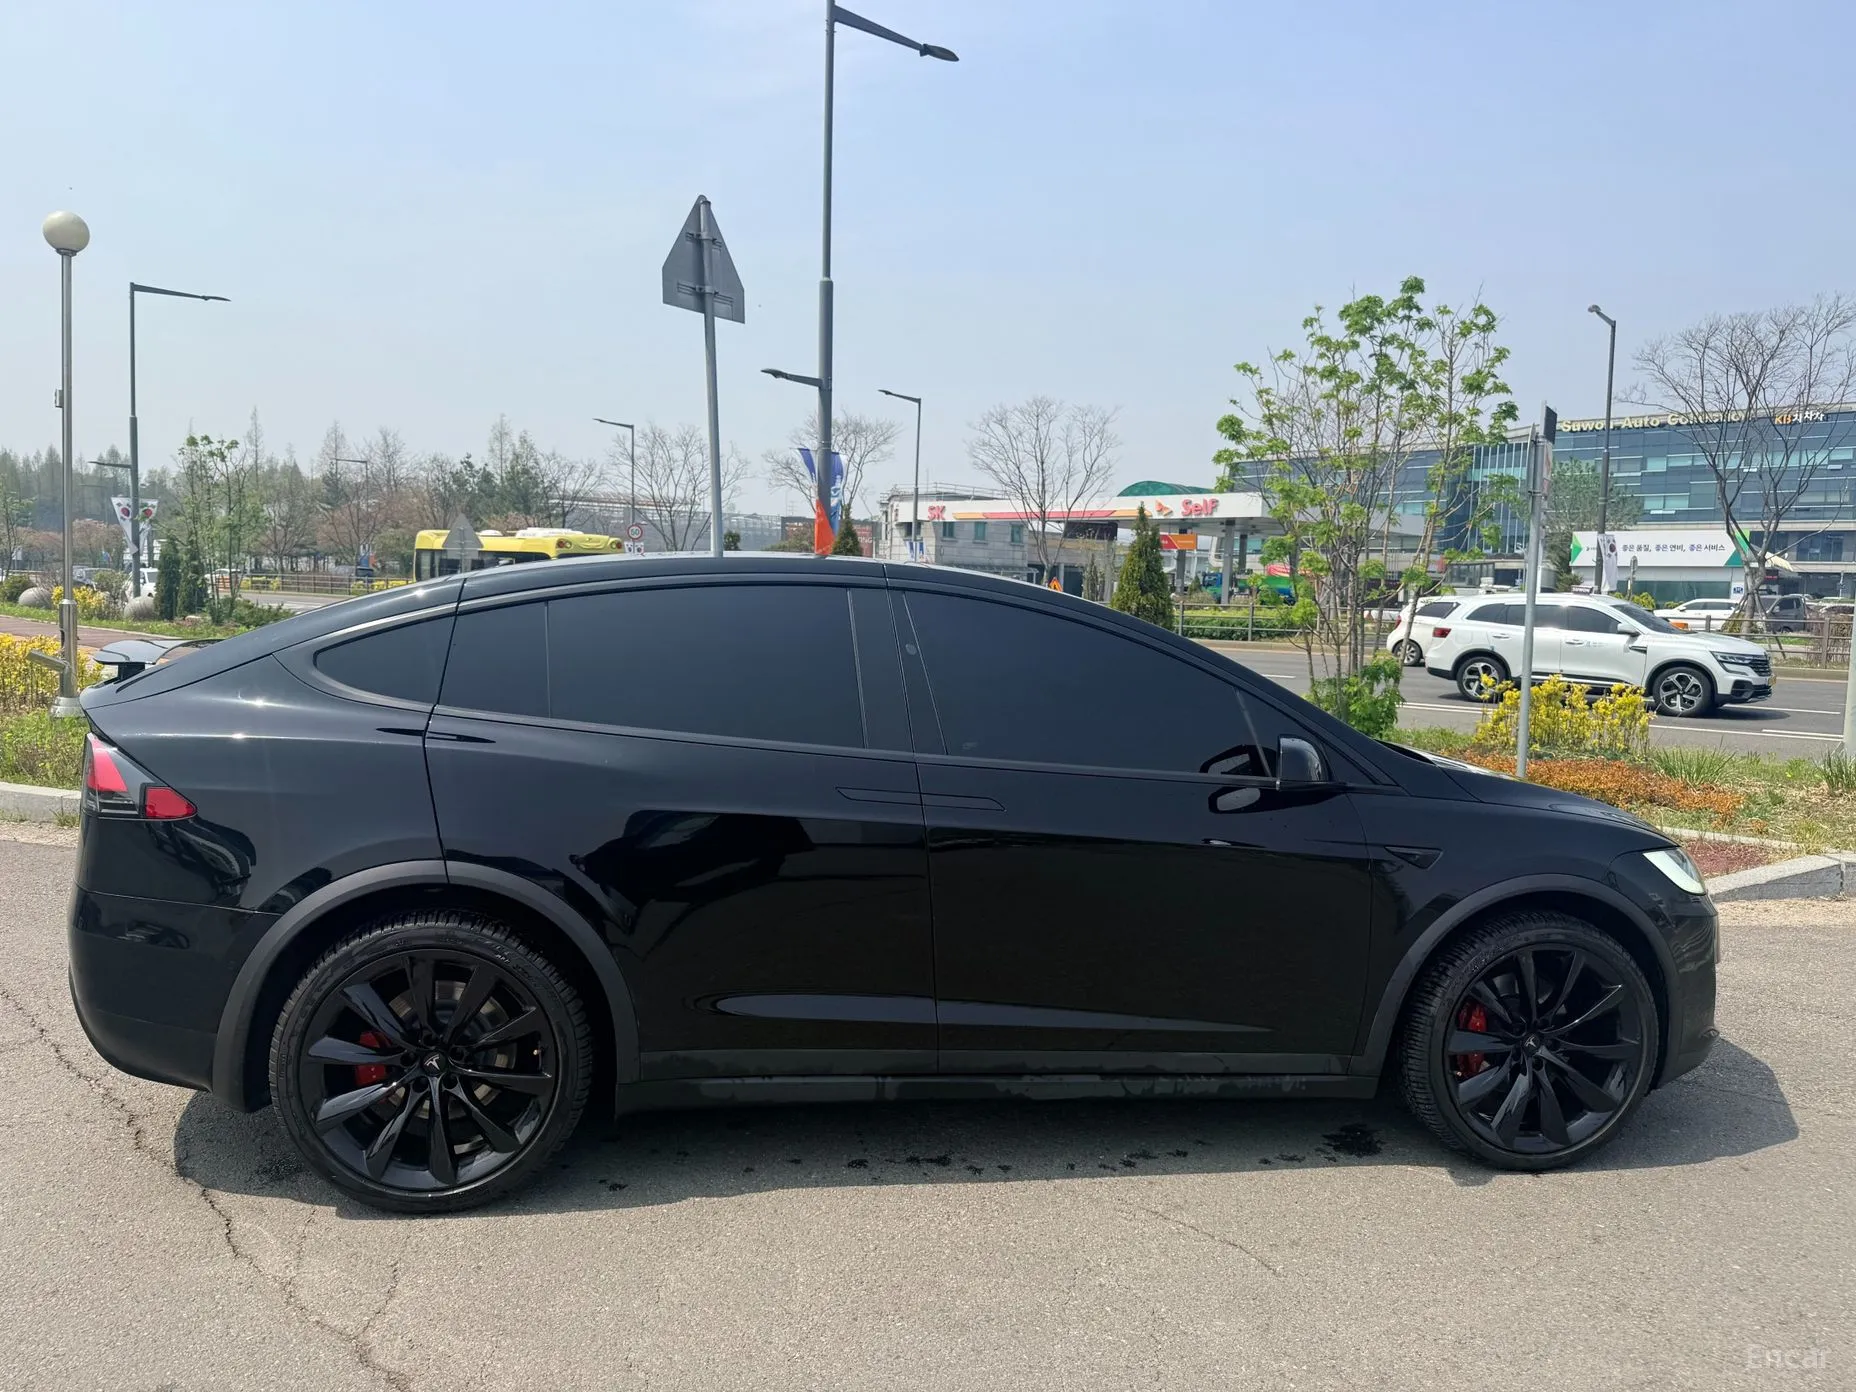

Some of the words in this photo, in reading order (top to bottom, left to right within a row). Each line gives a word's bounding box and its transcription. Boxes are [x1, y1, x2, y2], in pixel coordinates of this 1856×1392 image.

[1621, 417, 1660, 429] Auto
[928, 506, 946, 521] SK
[1181, 498, 1220, 517] Self
[1703, 544, 1726, 552] 서비스
